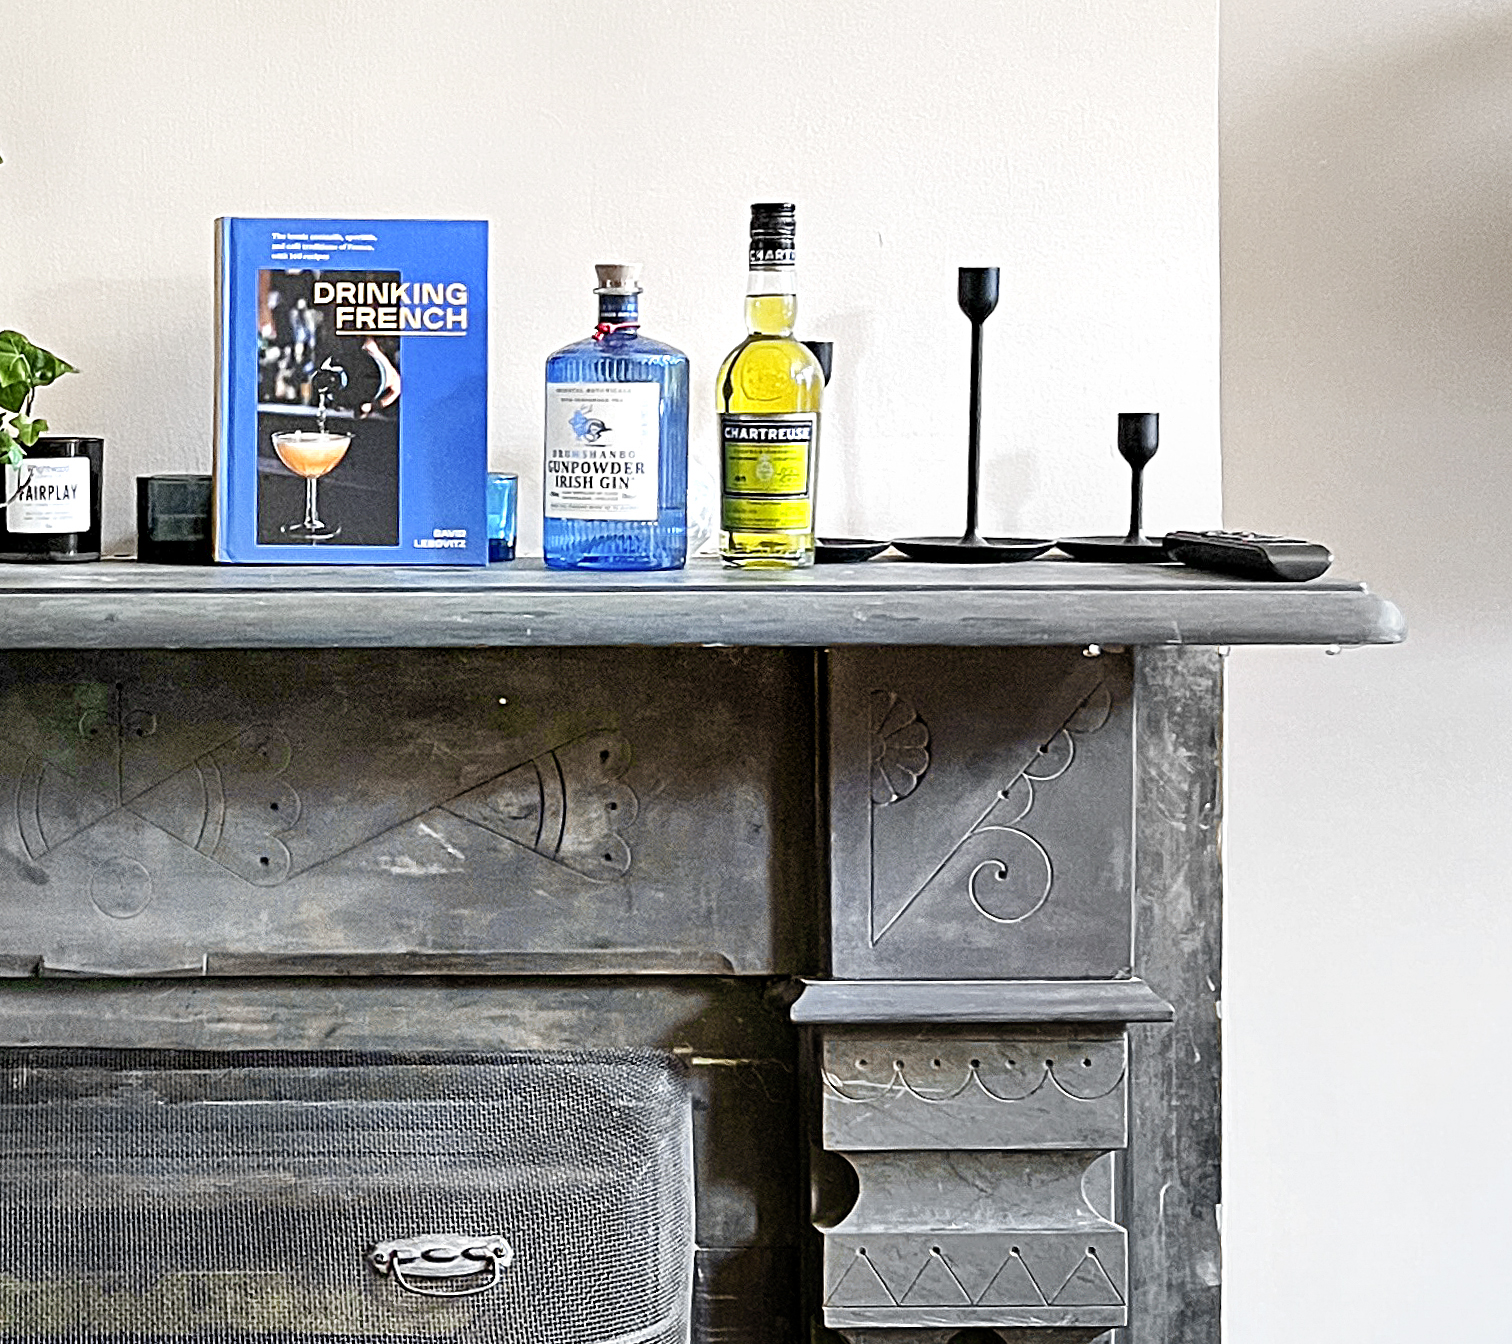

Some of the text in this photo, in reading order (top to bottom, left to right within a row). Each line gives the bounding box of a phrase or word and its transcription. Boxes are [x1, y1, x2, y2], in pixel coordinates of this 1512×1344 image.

[313, 281, 468, 306] DRINKING
[336, 306, 468, 330] FRENCH
[724, 427, 811, 441] CHARTREUSE
[548, 460, 646, 475] GUNPOWDER
[555, 475, 630, 490] IRISH GIN
